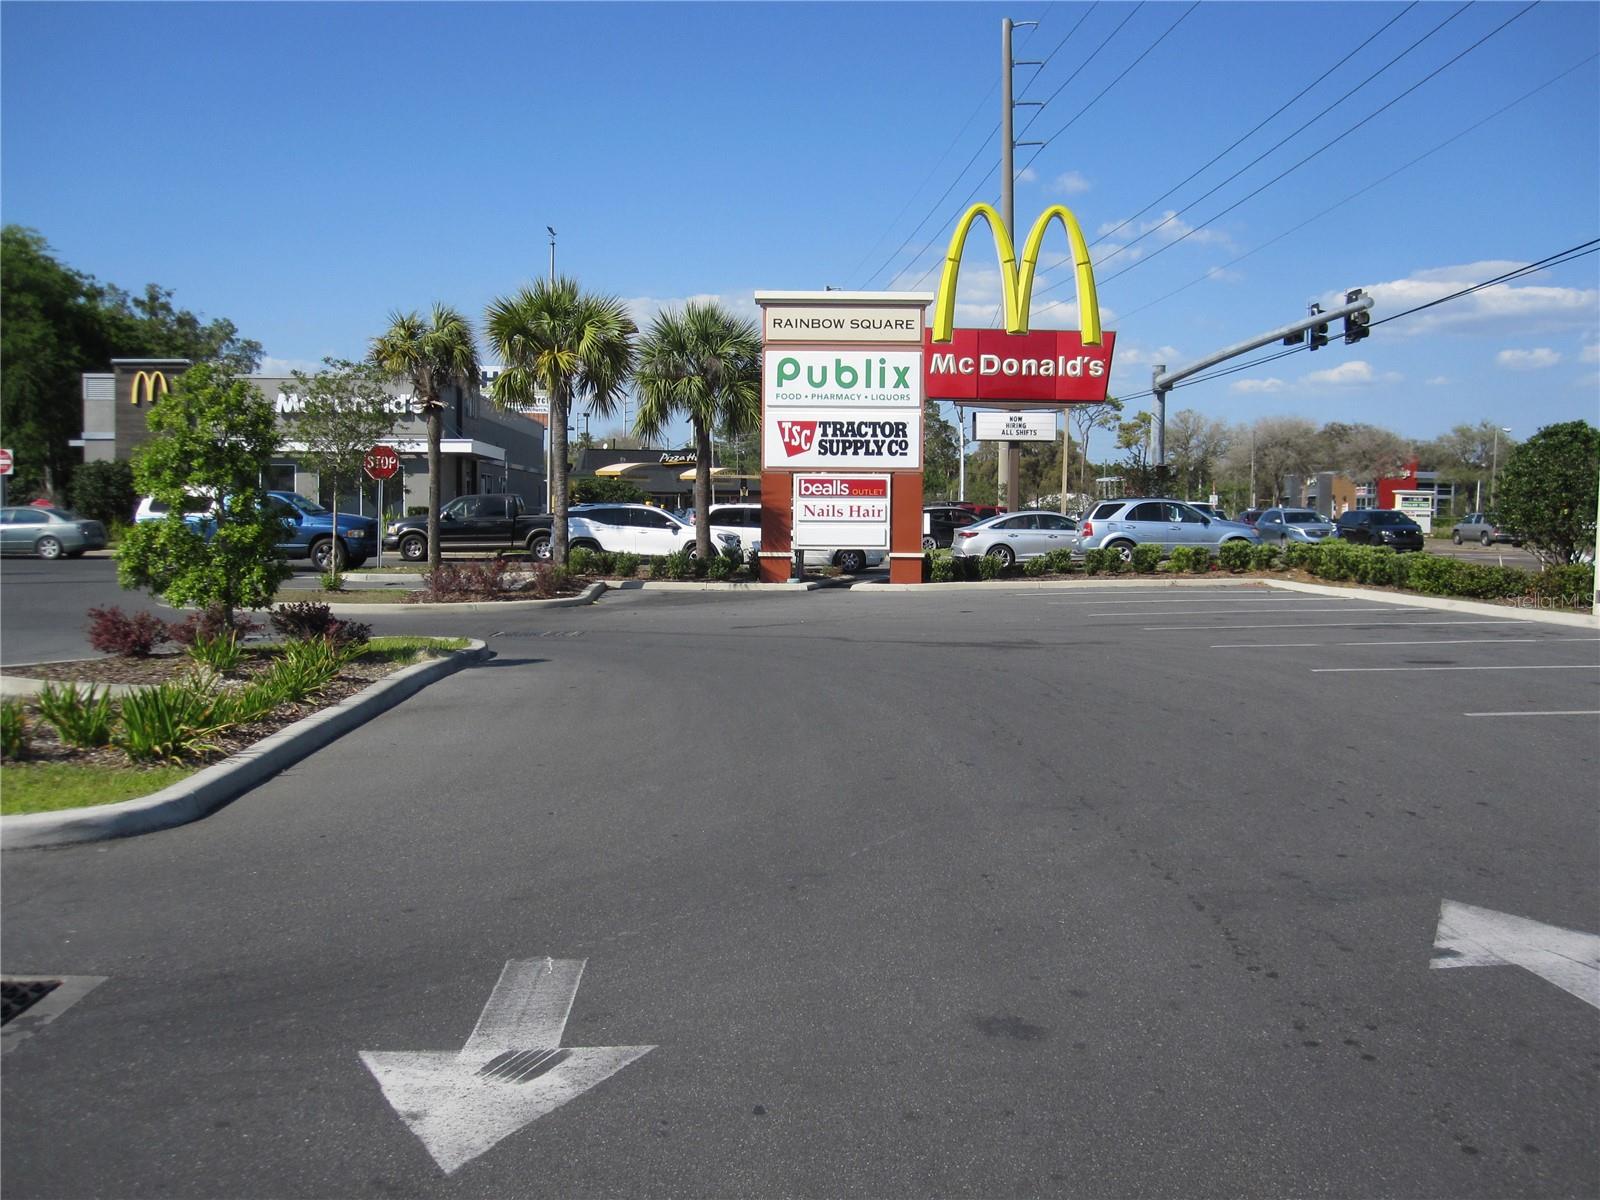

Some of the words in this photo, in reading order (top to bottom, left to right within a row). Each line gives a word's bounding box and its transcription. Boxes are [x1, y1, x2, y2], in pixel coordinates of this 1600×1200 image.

[772, 318, 845, 329] RAINBOW
[850, 319, 915, 330] SQUARE
[776, 357, 910, 389] Publix
[775, 393, 802, 401] FOOD
[811, 393, 862, 401] PHARMACY
[870, 393, 911, 401] LIQUORS
[781, 422, 811, 450] TSC
[818, 421, 908, 438] TRACTOR
[818, 439, 887, 457] SUPPLY
[367, 455, 397, 470] STOP
[659, 452, 686, 463] Pizza
[800, 480, 849, 496] bealls
[852, 488, 884, 496] OUTLET
[803, 504, 844, 518] Nails
[849, 505, 884, 518] Hair
